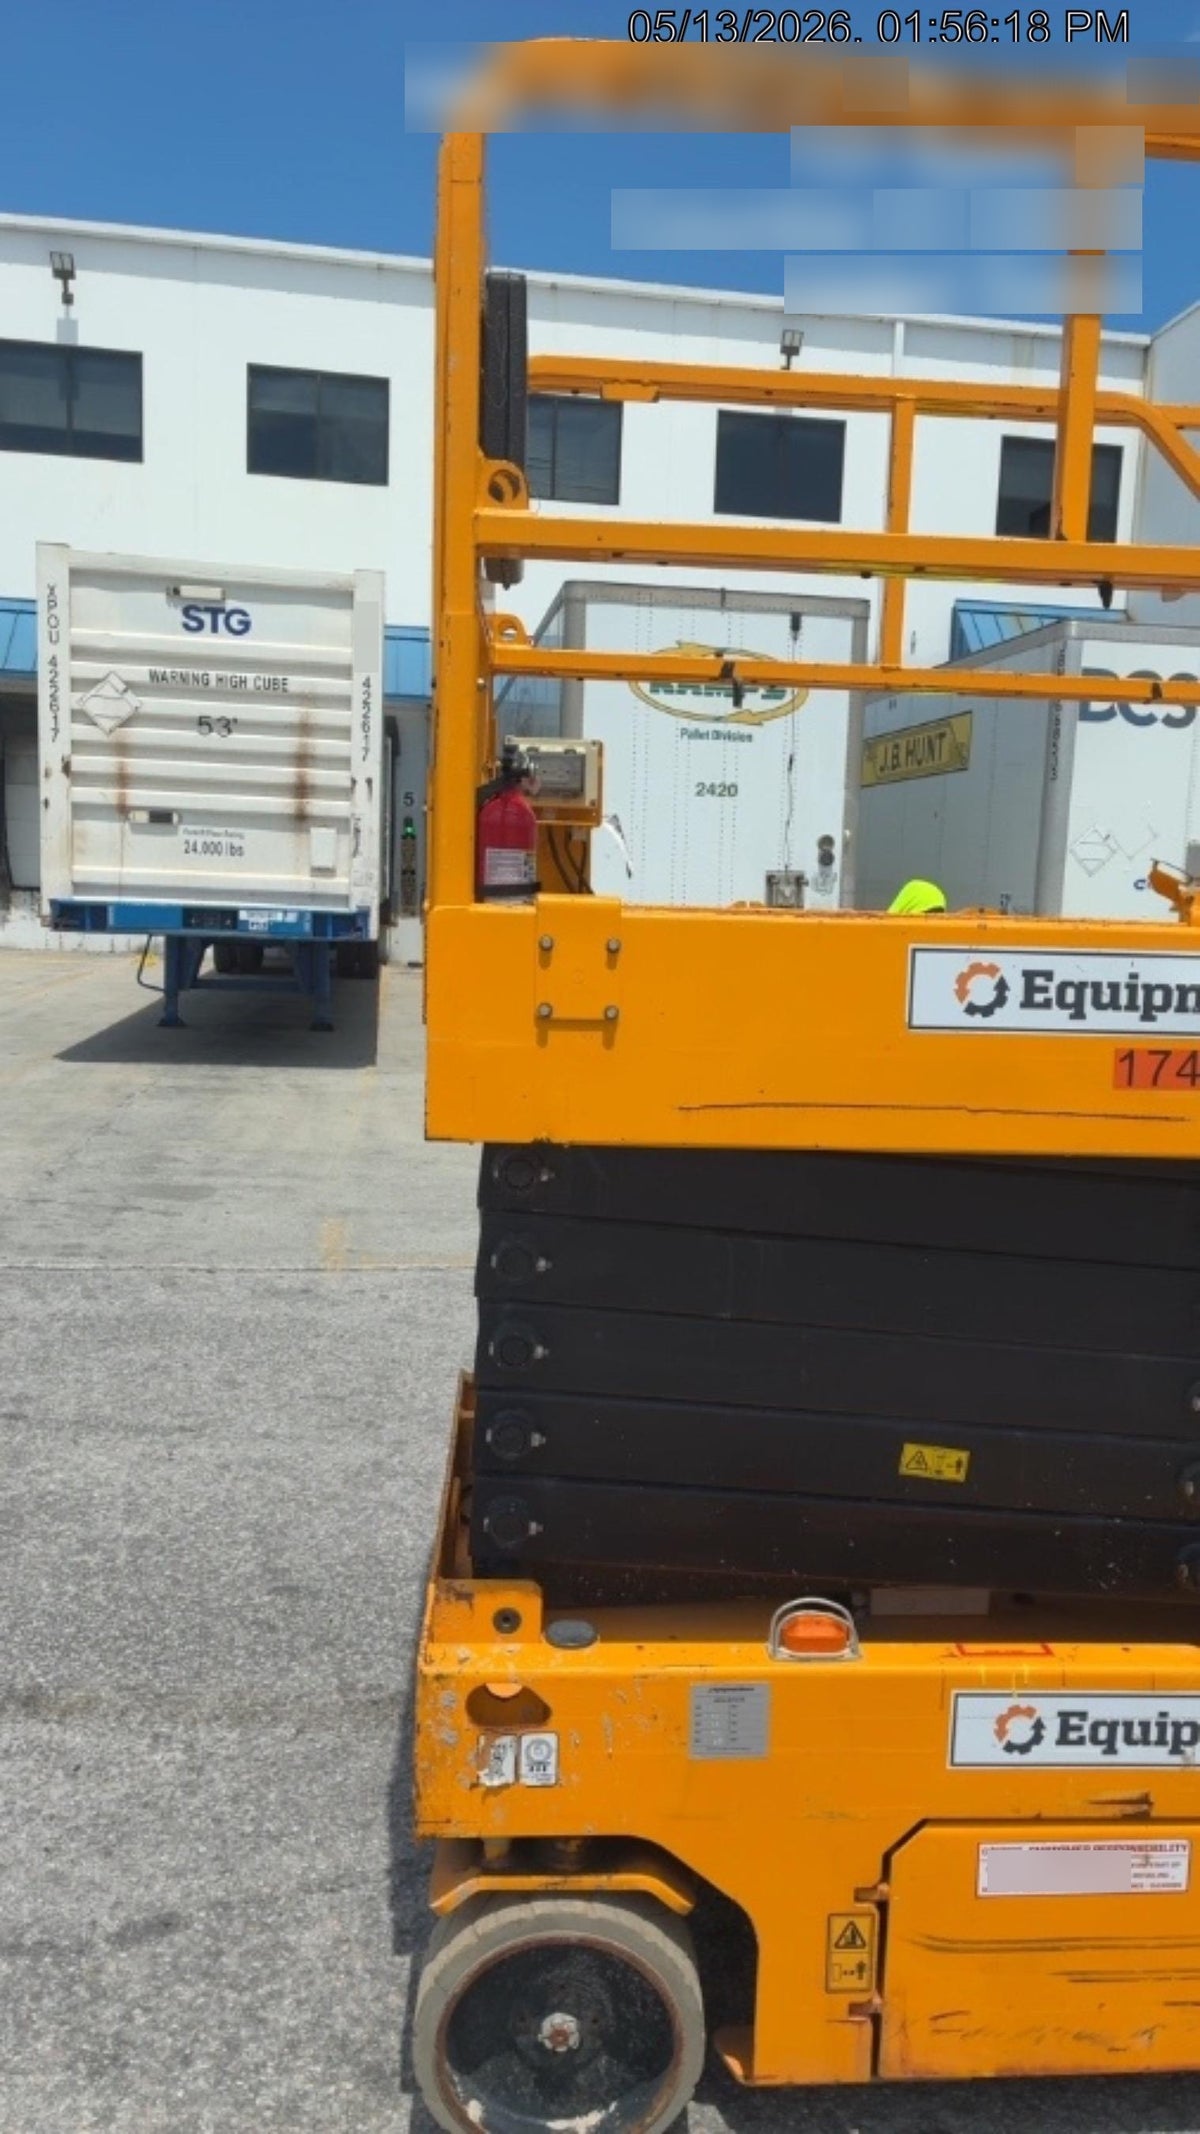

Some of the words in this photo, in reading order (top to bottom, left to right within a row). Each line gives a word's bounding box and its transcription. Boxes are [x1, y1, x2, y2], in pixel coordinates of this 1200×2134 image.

[47, 583, 60, 645] XPOU
[182, 604, 252, 635] STG
[149, 669, 210, 687] WARNING
[215, 673, 247, 689] HIGH
[253, 676, 289, 693] CUBE
[47, 654, 60, 743] 422617
[197, 715, 238, 738] 53'
[360, 675, 371, 762] 422617
[680, 728, 710, 741] Pallet
[711, 730, 753, 743] Division
[905, 731, 947, 768] HUNT
[403, 791, 414, 806] 5
[695, 782, 738, 797] 2420
[225, 840, 245, 856] lbs
[1118, 1049, 1200, 1087] 174
[1055, 1711, 1200, 1755] Equip
